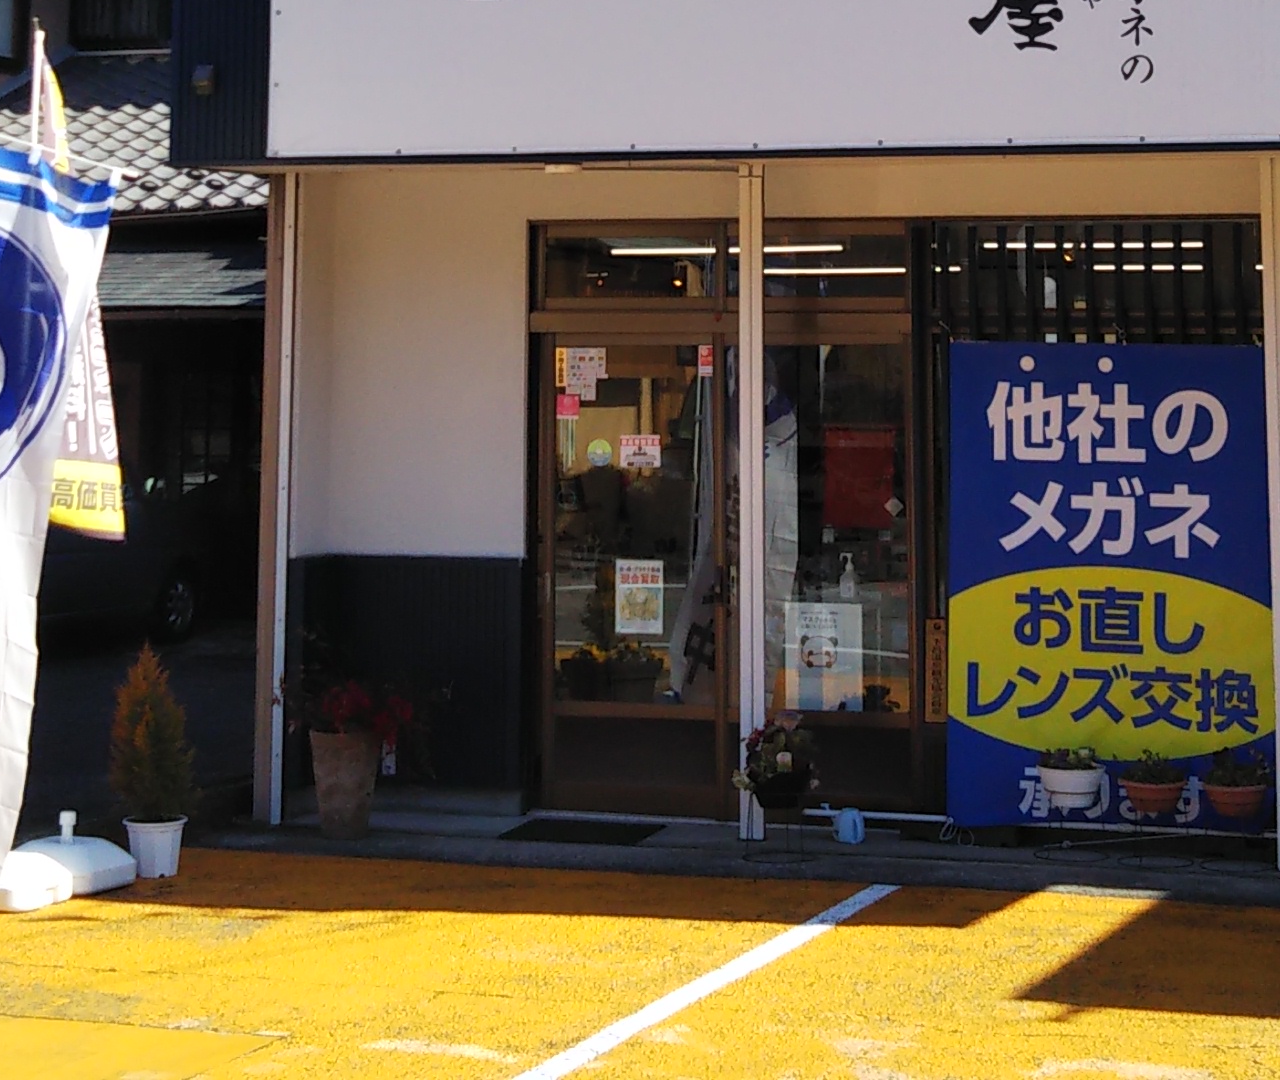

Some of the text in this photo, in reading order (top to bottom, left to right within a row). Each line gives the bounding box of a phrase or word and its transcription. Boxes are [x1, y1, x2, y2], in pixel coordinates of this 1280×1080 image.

[987, 381, 1229, 463] 他社の
[51, 477, 126, 513] 高価買
[998, 476, 1221, 559] メガネ
[1014, 586, 1205, 655] お直し
[966, 662, 1260, 734] レンズ交換
